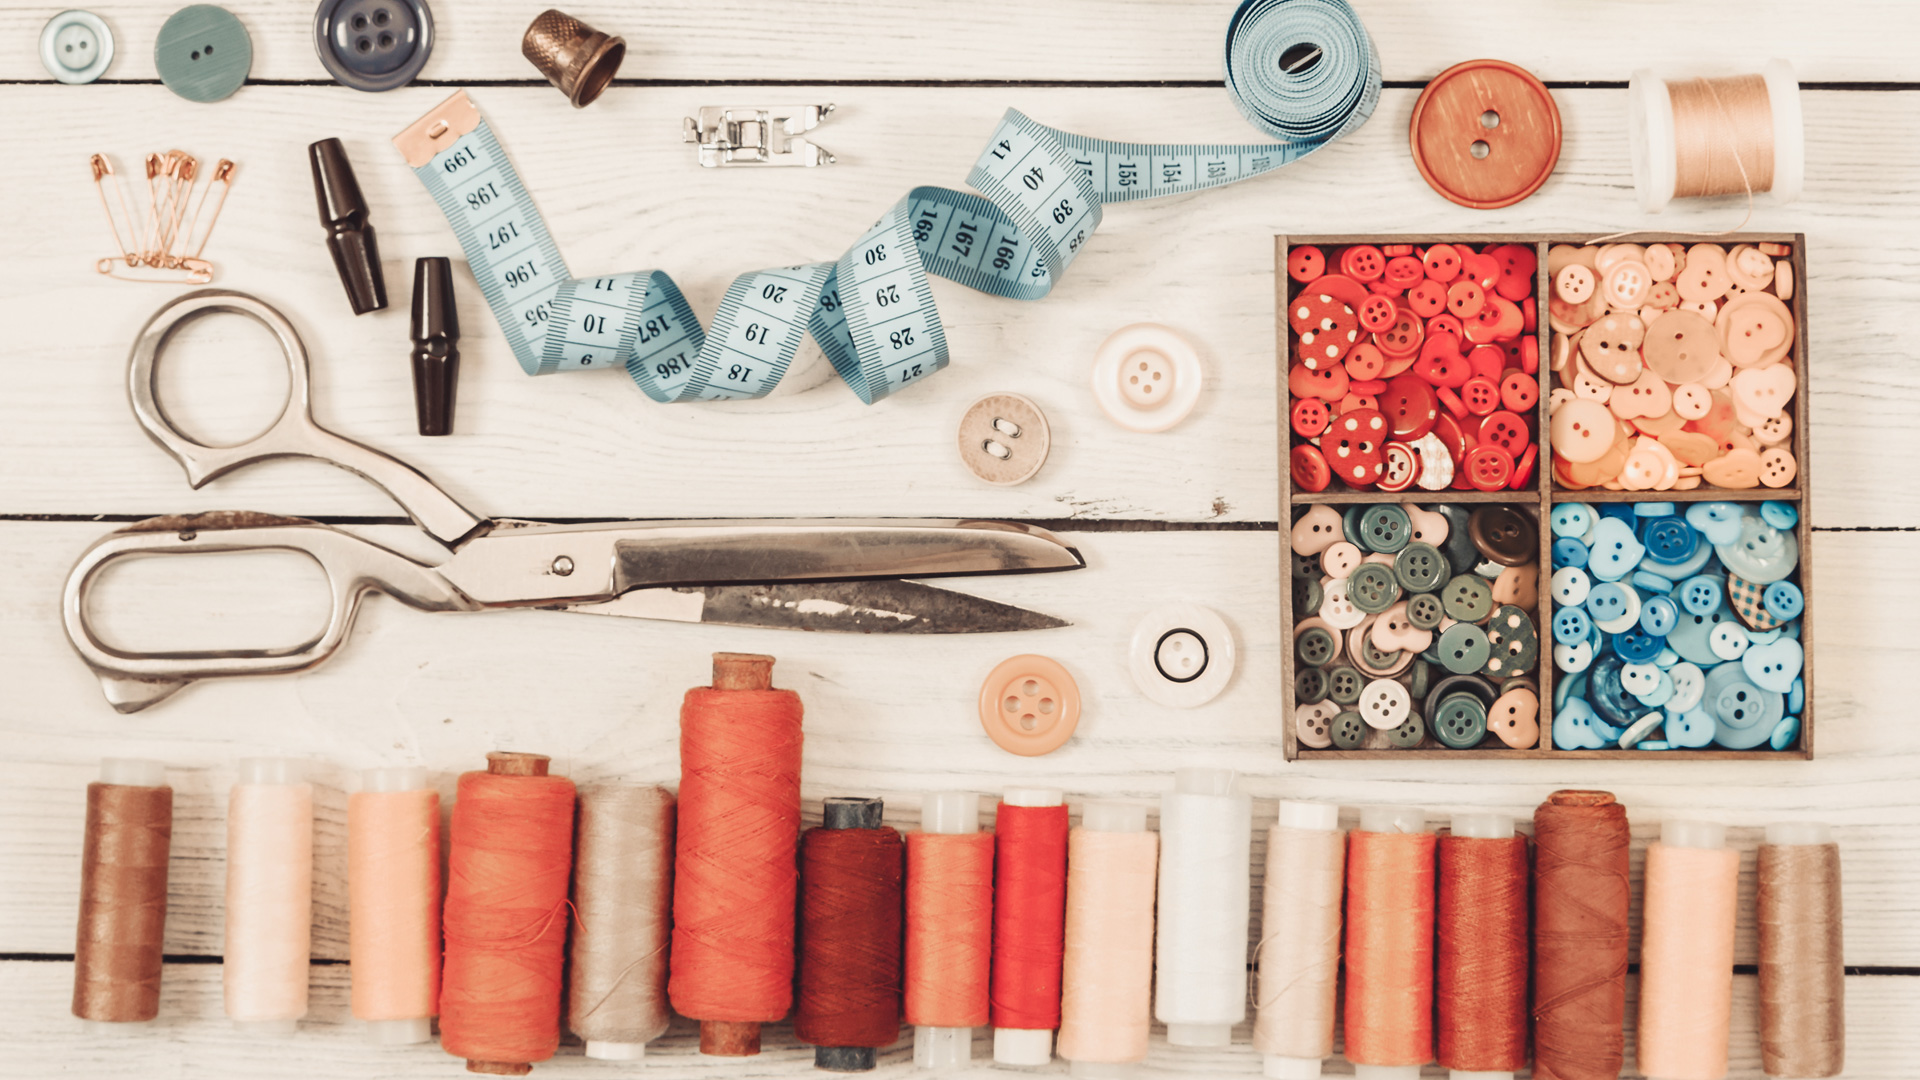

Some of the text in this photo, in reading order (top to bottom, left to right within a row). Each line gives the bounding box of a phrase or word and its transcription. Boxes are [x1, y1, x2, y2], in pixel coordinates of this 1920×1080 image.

[444, 145, 477, 173] 199
[990, 139, 1012, 160] 41
[1023, 167, 1046, 191] 40
[1118, 162, 1137, 186] 155
[1163, 163, 1182, 184] 154
[466, 182, 500, 210] 198
[1052, 199, 1073, 224] 39
[489, 222, 520, 250] 197
[913, 209, 937, 242] 168
[952, 221, 978, 258] 167
[1069, 229, 1085, 253] 38
[865, 244, 887, 265] 30
[993, 235, 1019, 271] 166
[505, 261, 539, 288] 196
[595, 278, 616, 291] 11
[762, 284, 788, 304] 20
[876, 284, 900, 308] 29
[583, 314, 607, 334] 10
[638, 314, 671, 344] 187
[745, 323, 770, 345] 19
[889, 327, 915, 350] 28
[580, 354, 593, 365] 9
[656, 352, 692, 379] 186
[727, 364, 753, 383] 18
[901, 364, 923, 383] 27
